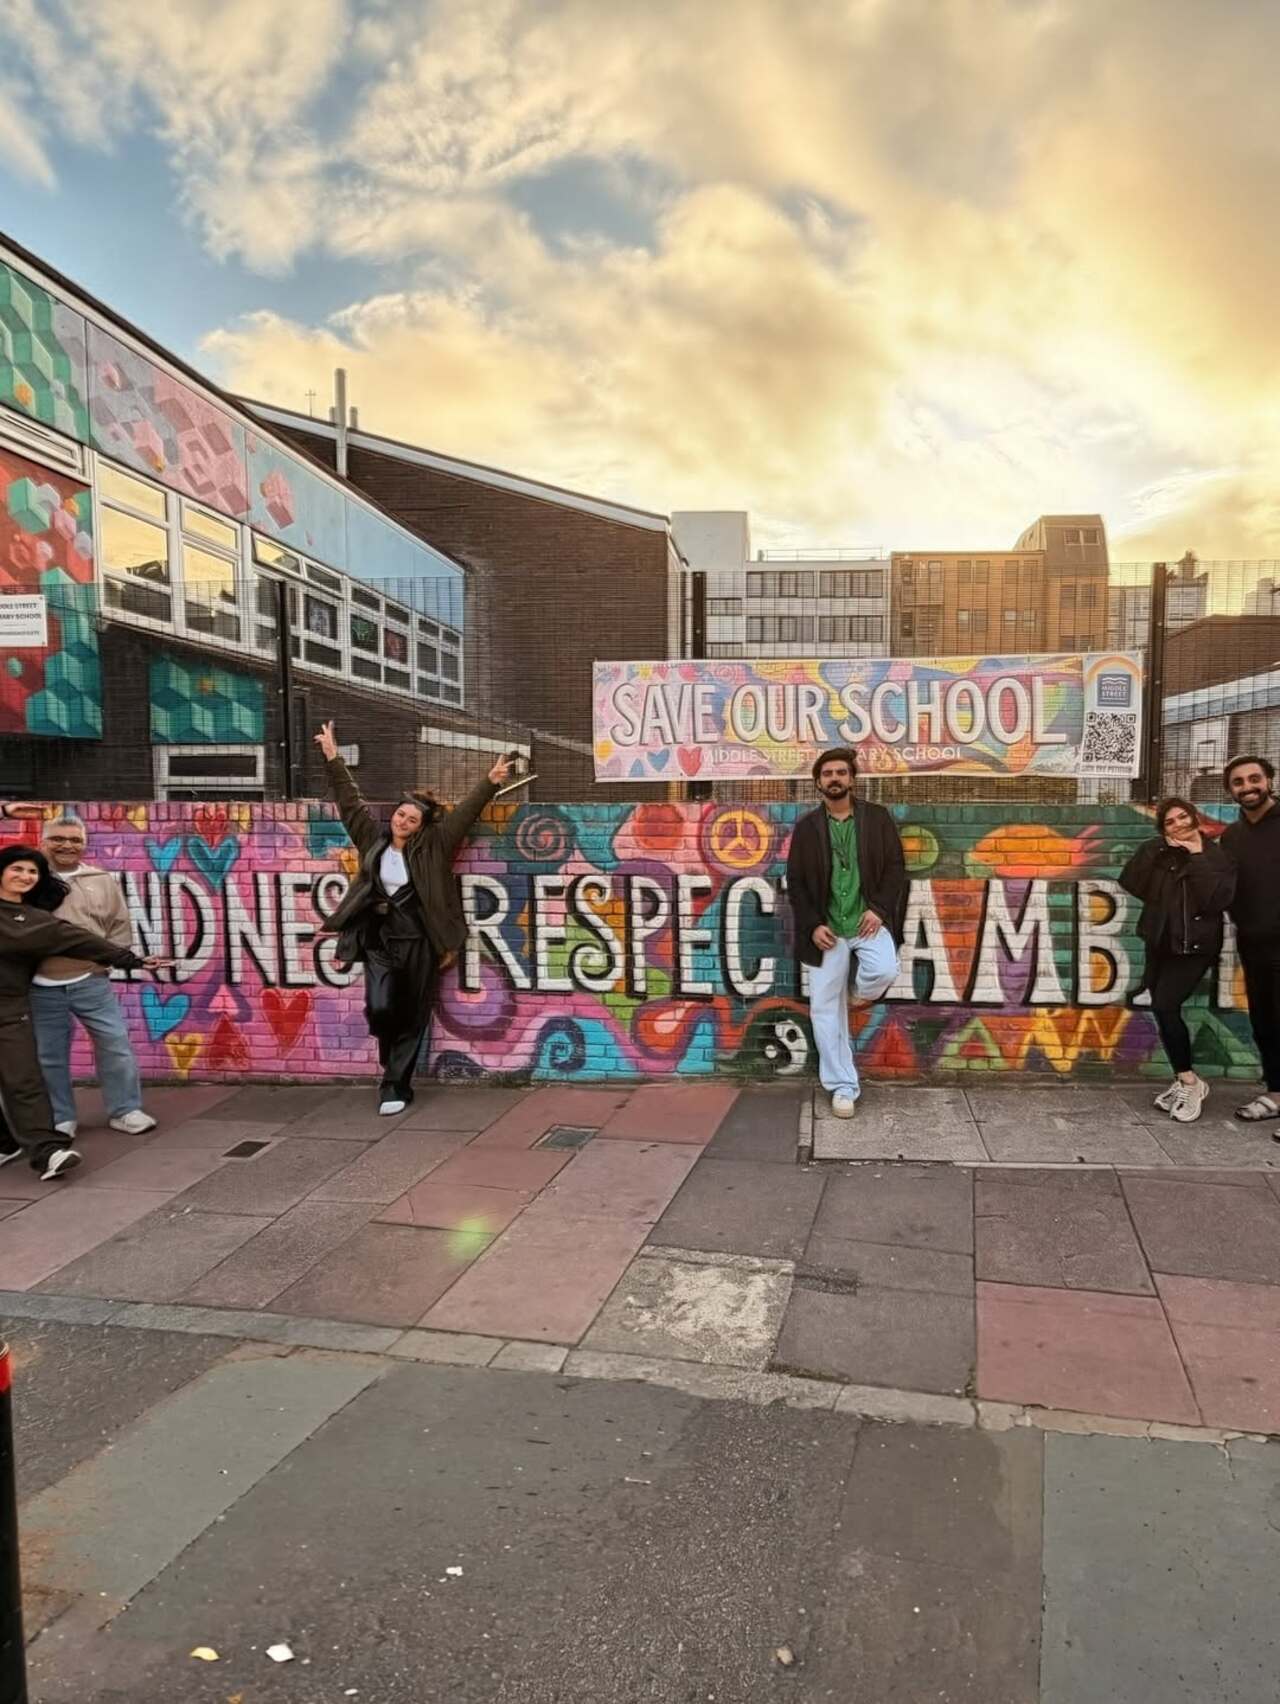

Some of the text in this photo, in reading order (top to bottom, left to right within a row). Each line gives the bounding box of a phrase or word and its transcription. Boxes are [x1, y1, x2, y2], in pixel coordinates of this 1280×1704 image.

[611, 676, 1067, 746] SAVE OUR SCHOOL
[702, 747, 757, 762] MIDDLE
[461, 872, 811, 999] RESPEC
